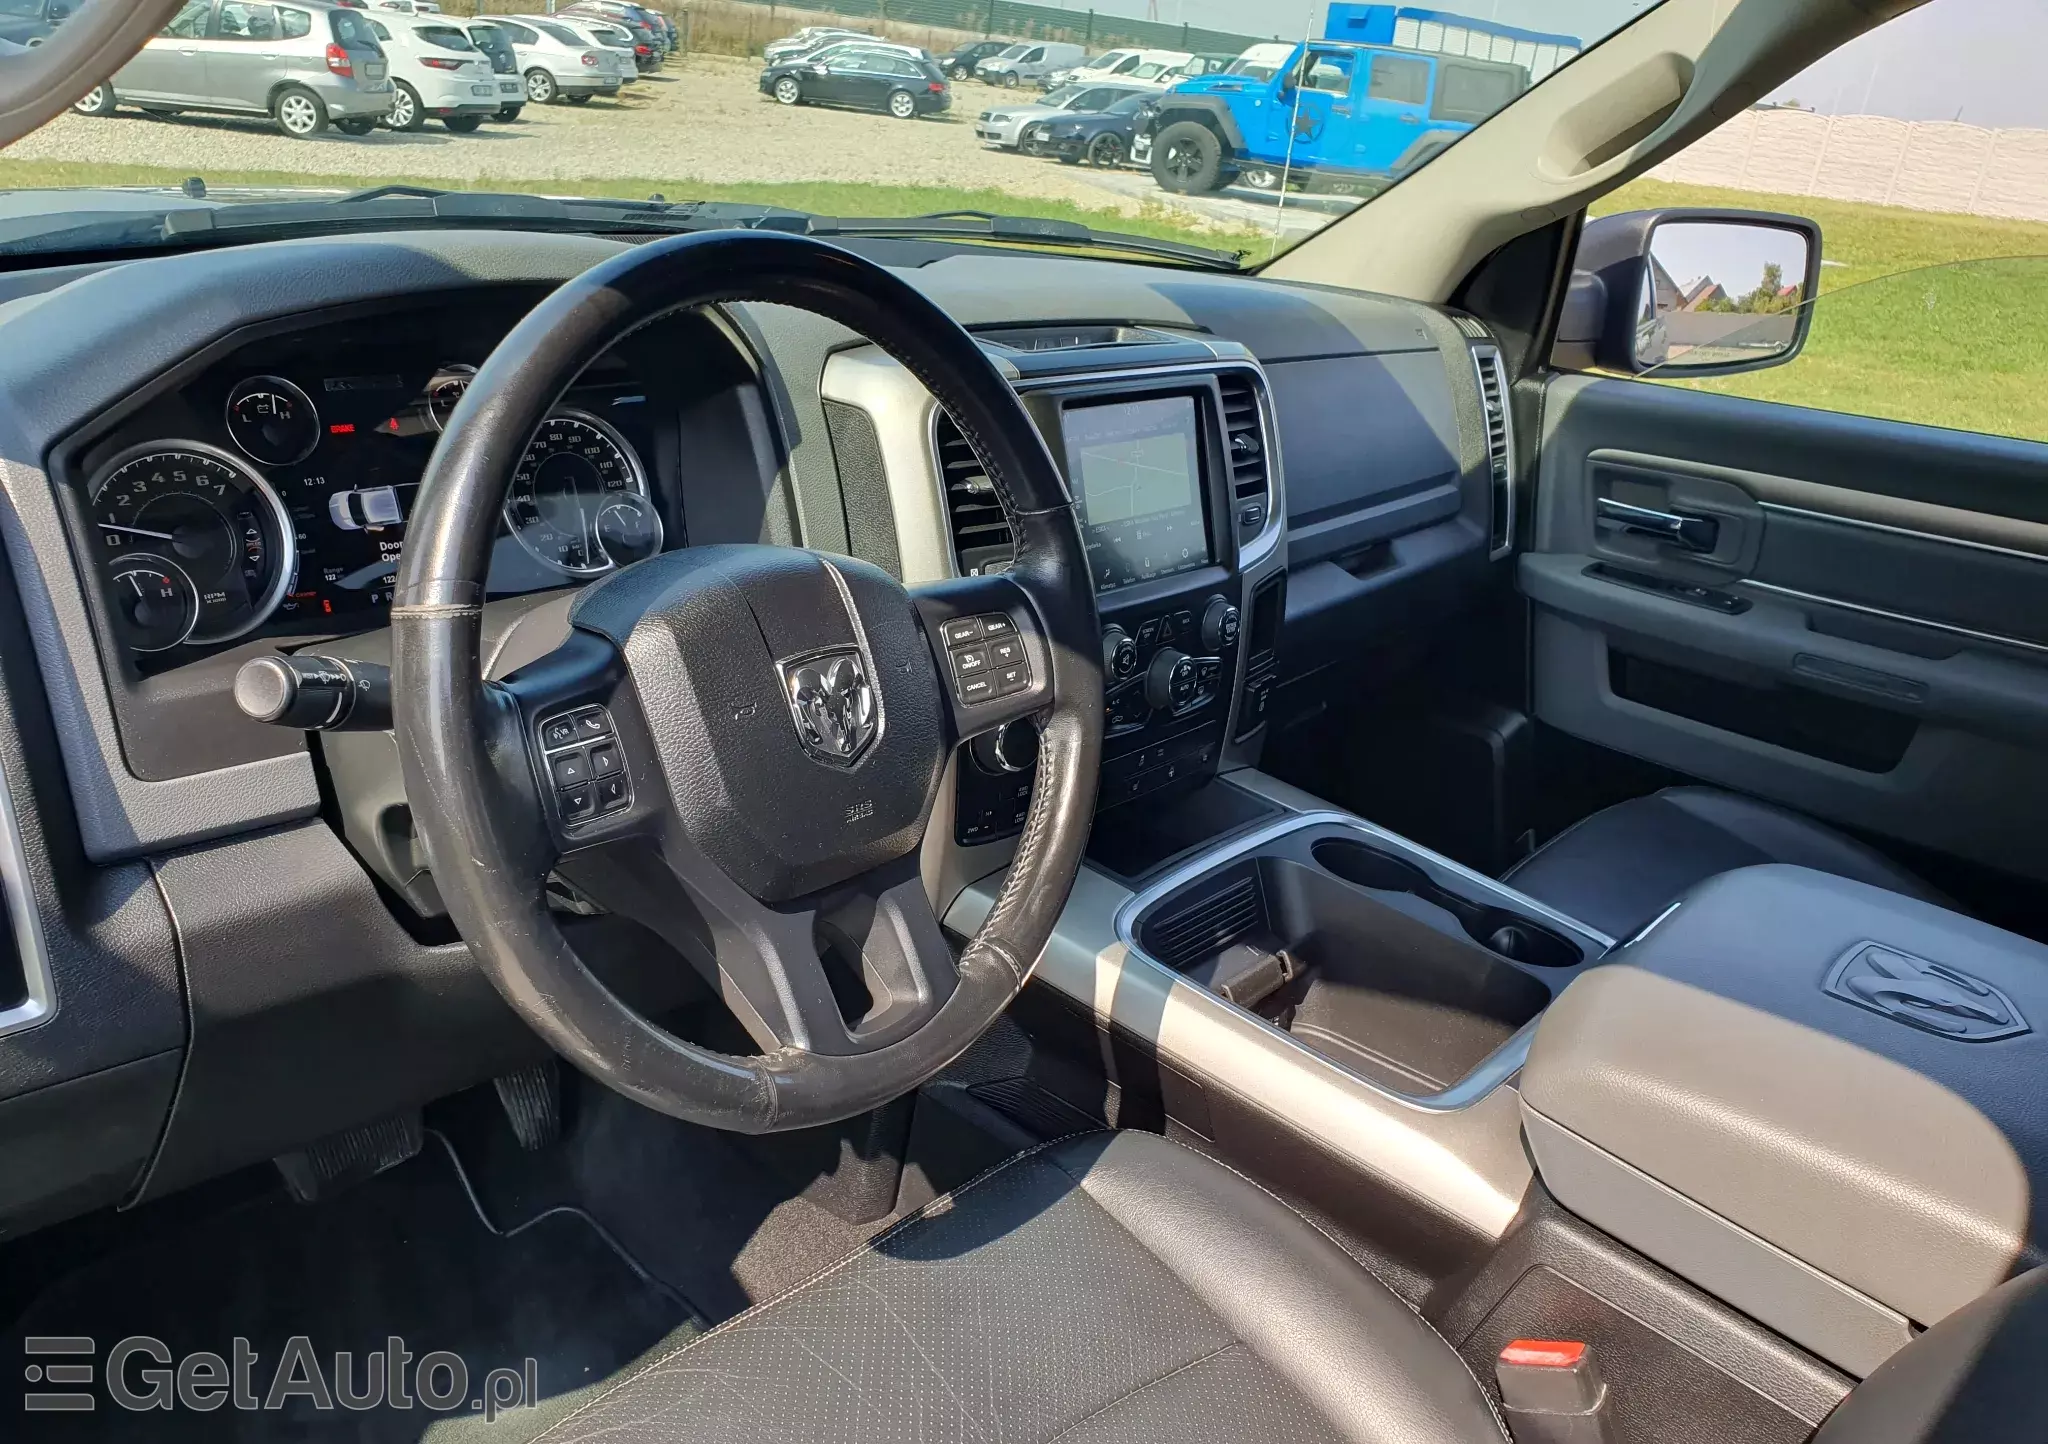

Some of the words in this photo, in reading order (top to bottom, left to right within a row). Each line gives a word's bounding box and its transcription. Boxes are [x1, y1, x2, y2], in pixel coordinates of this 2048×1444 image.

[242, 413, 252, 423] L
[279, 411, 291, 420] H
[330, 423, 355, 433] BRAKE
[549, 433, 563, 441] 80
[568, 435, 582, 443] 90
[532, 441, 547, 449] 70
[151, 472, 165, 483] 4
[173, 470, 187, 482] 5
[195, 475, 210, 486] 6
[132, 480, 147, 492] 3
[303, 476, 326, 487] 12:13
[213, 484, 226, 496] 7
[116, 494, 131, 506] 2
[108, 512, 117, 524] 1
[106, 534, 121, 546] 0
[379, 541, 404, 551] Door
[381, 552, 402, 563] Ope
[325, 574, 337, 582] 122
[160, 587, 173, 597] H
[371, 594, 379, 603] P
[1000, 646, 1011, 654] RES
[962, 659, 982, 670] ON/OFF
[1006, 671, 1017, 679] SET
[966, 681, 988, 692] CANCEL
[967, 826, 979, 834] 2WD
